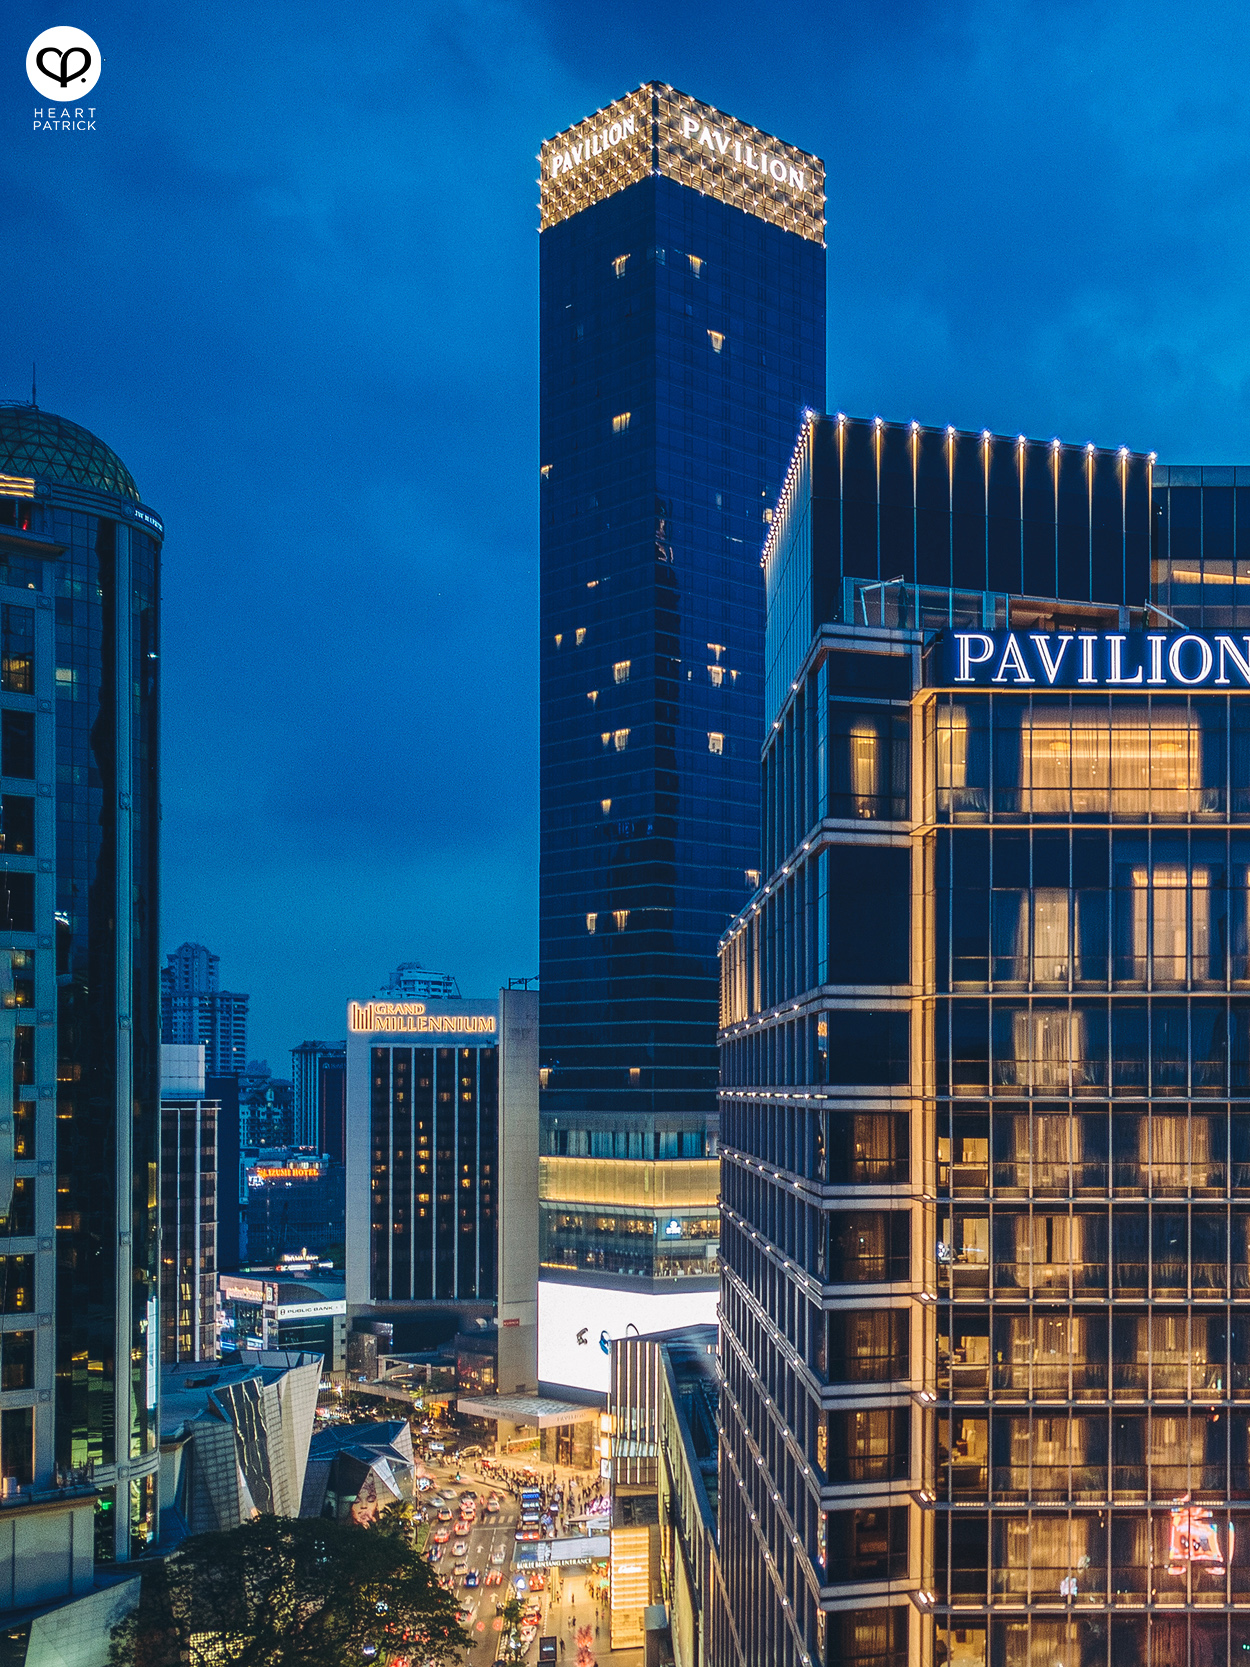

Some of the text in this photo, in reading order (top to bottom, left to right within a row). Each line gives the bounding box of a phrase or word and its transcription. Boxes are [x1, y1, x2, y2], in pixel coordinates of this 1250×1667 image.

[551, 113, 636, 178] PAVILION
[681, 115, 806, 190] PAVILION
[375, 1003, 426, 1015] GRAND
[375, 1016, 496, 1032] MILLENNIUM
[292, 1168, 319, 1177] HOTEL
[561, 1557, 592, 1566] ENTRANCE
